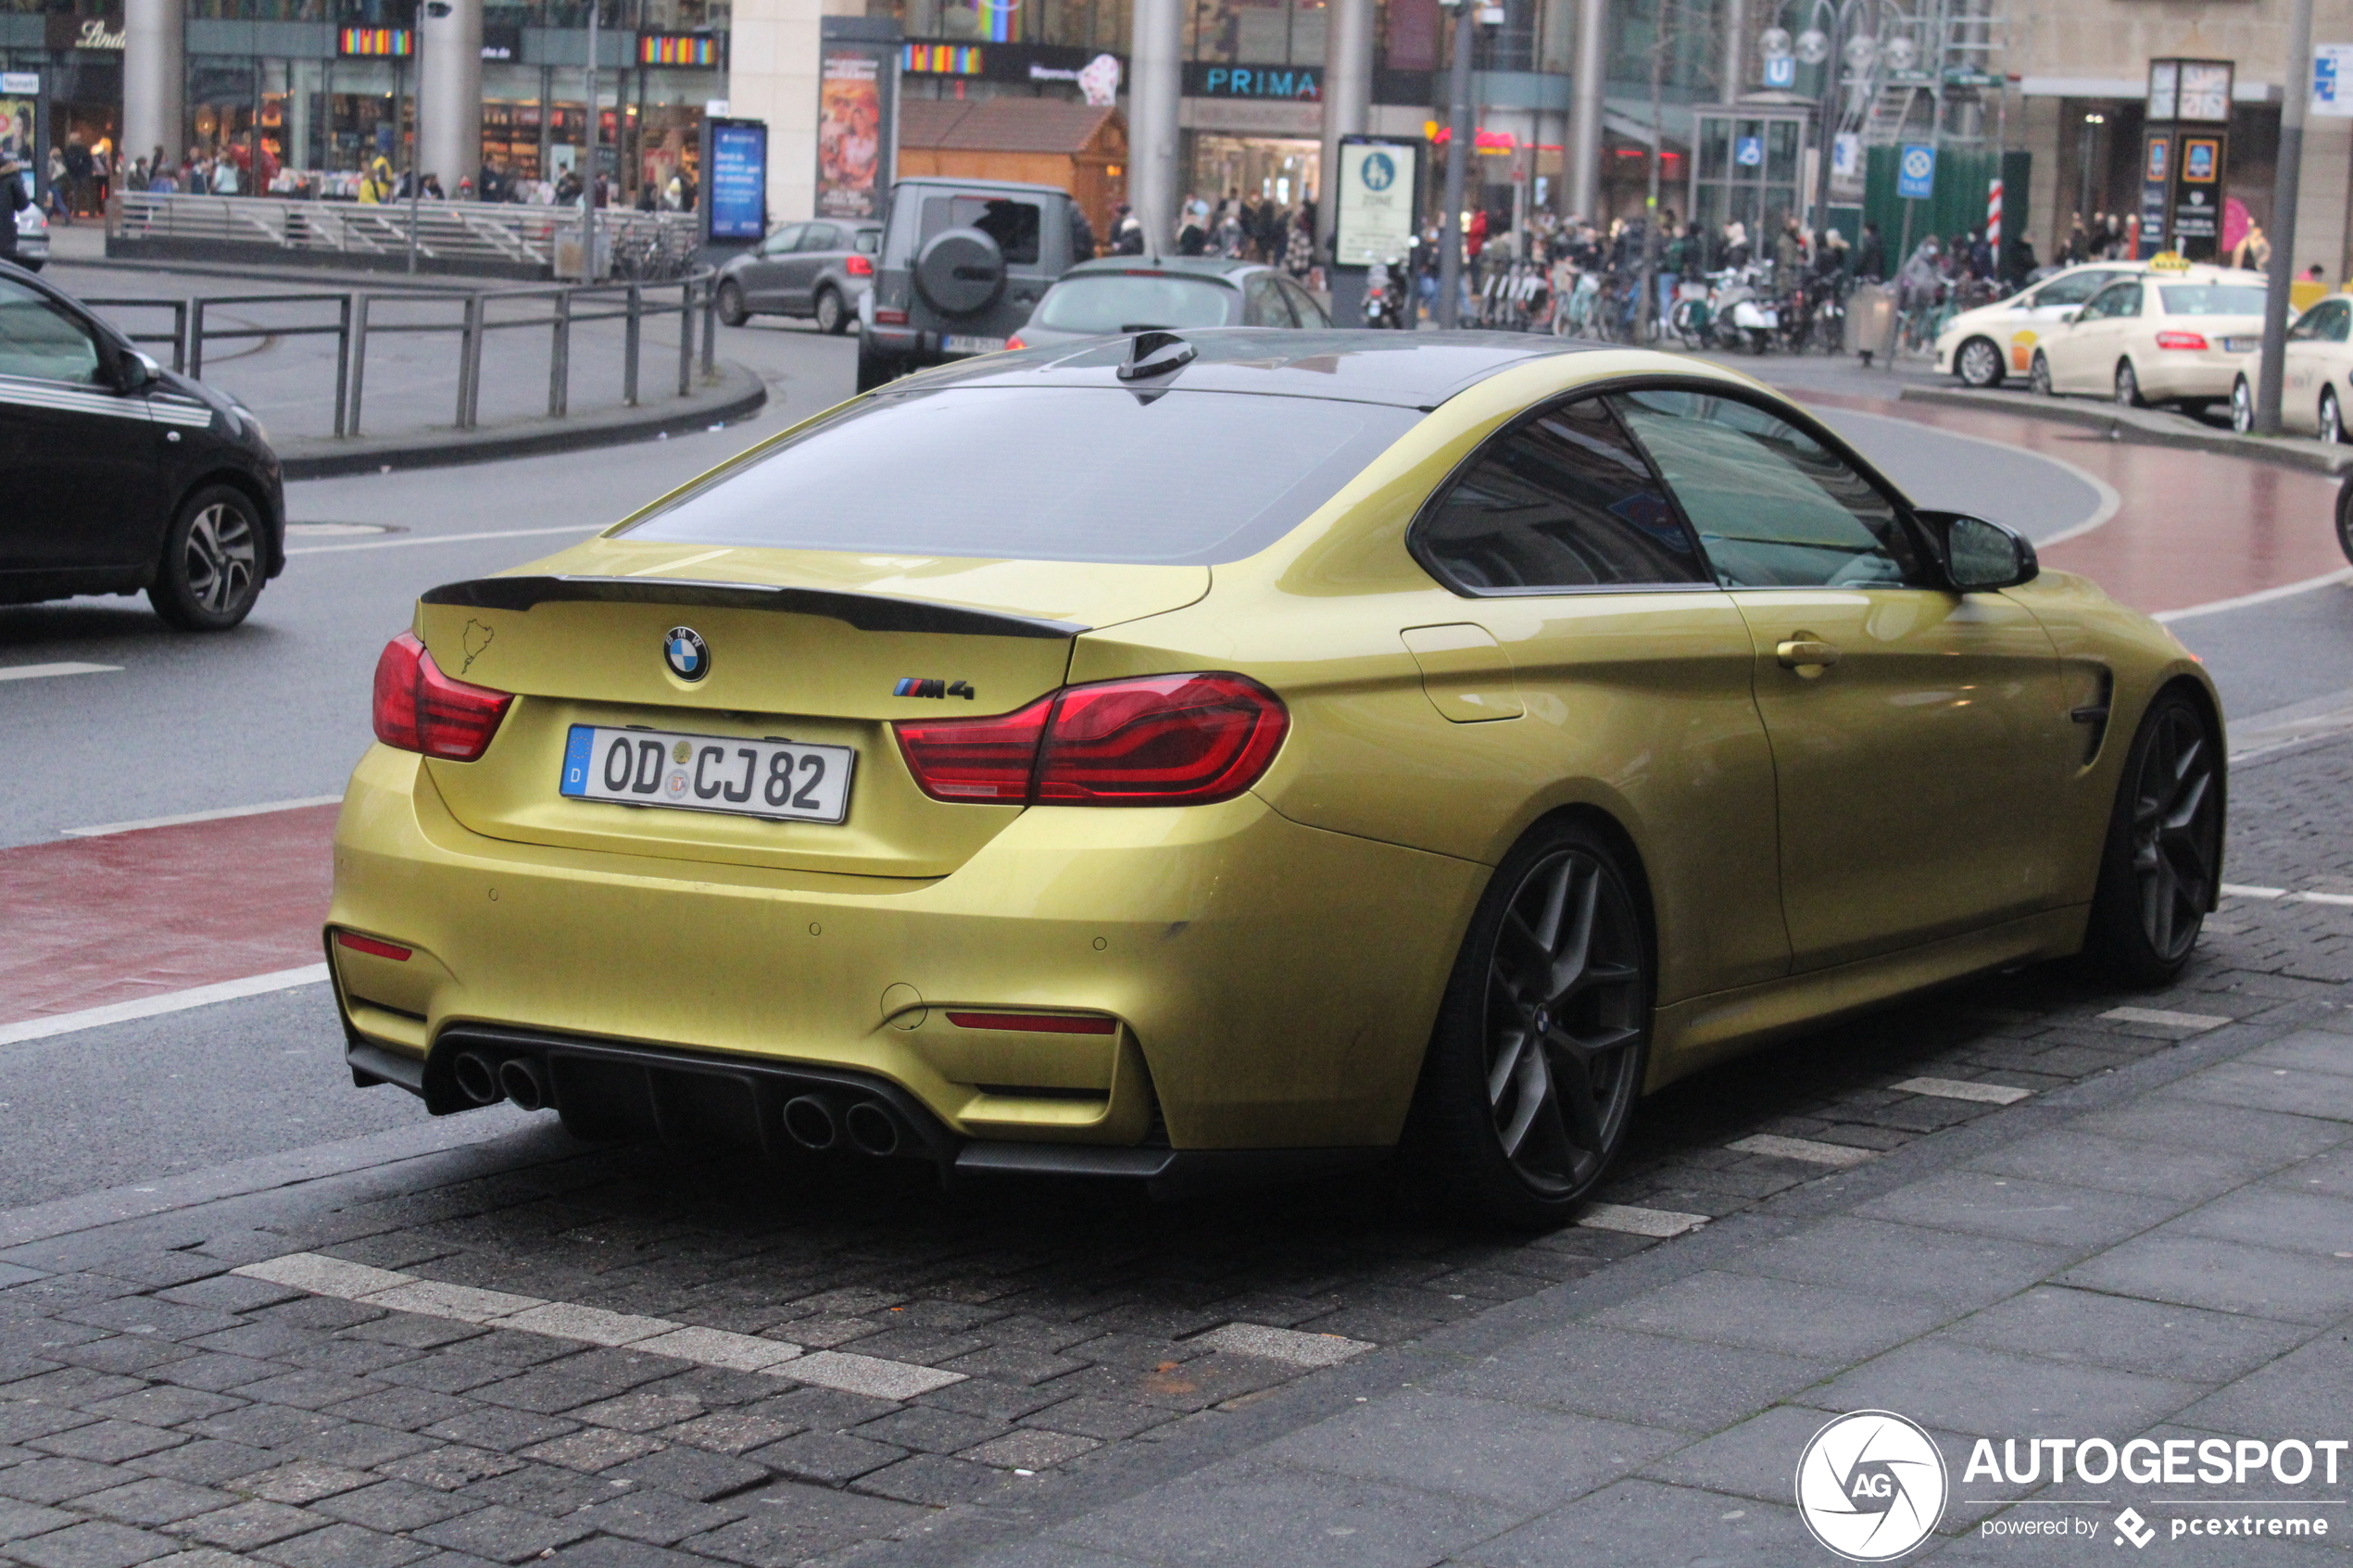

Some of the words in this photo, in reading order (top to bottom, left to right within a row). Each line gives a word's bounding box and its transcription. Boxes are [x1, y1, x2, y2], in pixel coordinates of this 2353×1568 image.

[1770, 59, 1789, 82] U
[1207, 69, 1316, 95] PRIMA
[666, 629, 702, 648] BMW
[911, 678, 975, 700] M4
[570, 768, 581, 783] D
[604, 737, 666, 795] OD
